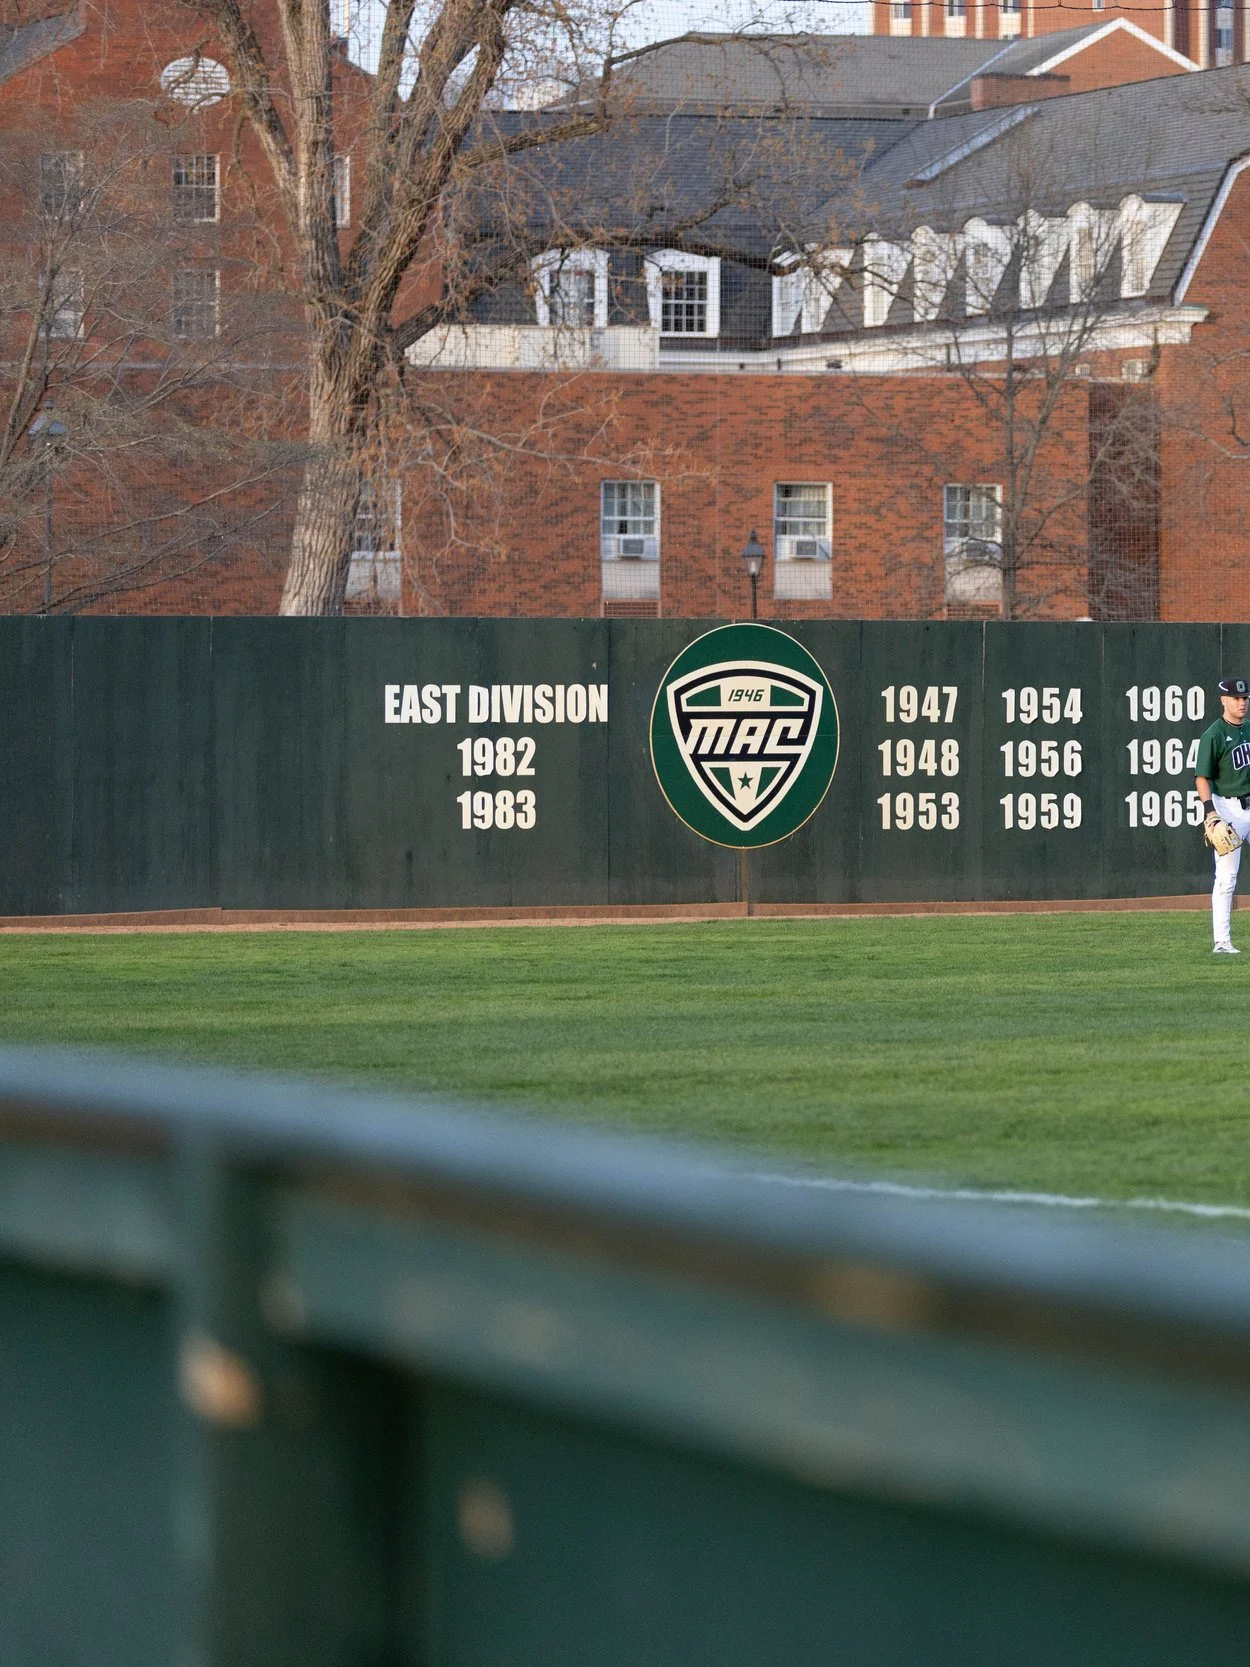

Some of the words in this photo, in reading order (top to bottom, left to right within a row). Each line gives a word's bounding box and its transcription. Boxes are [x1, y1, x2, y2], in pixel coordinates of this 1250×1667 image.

[384, 684, 462, 725] EAST
[468, 683, 609, 725] DIVISION
[727, 689, 765, 702] 1946
[881, 685, 958, 724] 1947
[1001, 686, 1084, 726] 1954
[1125, 685, 1206, 723] 1960
[685, 717, 806, 755] MAC
[456, 736, 537, 777] 1982
[877, 738, 960, 777] 1948
[999, 739, 1083, 778] 1956
[456, 789, 537, 830] 1983
[876, 791, 960, 831] 1953
[999, 792, 1083, 831] 1959
[1124, 789, 1205, 828] 1965
